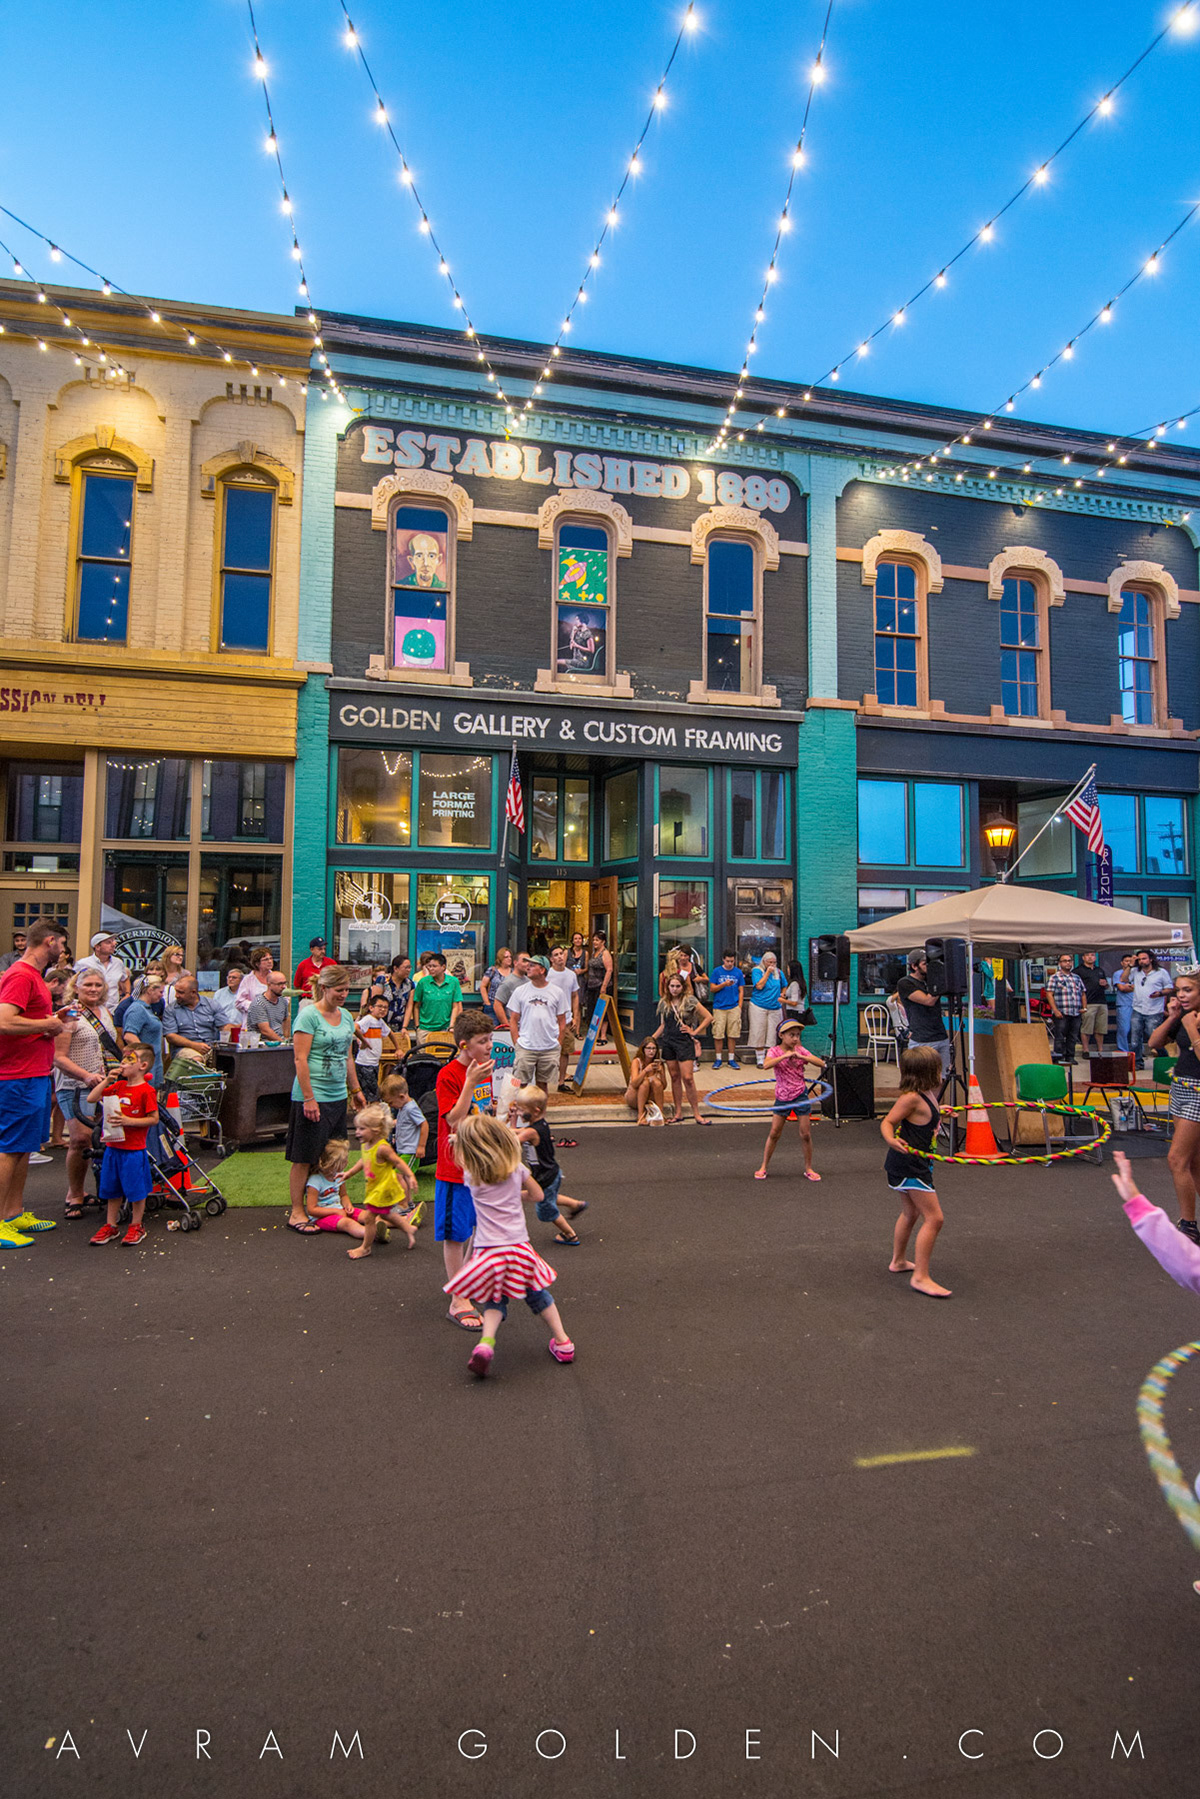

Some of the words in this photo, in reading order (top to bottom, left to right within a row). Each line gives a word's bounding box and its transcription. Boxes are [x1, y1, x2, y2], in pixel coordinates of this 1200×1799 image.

[361, 426, 691, 500] ESTABLISHED
[697, 469, 791, 513] 1889
[339, 704, 441, 732] GOLDEN
[453, 712, 551, 739] GALLERY
[559, 718, 576, 741] &
[583, 720, 677, 747] CUSTOM
[685, 727, 783, 753] FRAMING
[432, 791, 476, 800] LARGE
[432, 800, 476, 809] FORMAT
[432, 809, 476, 818] PRINTING
[1100, 848, 1110, 895] SALON
[115, 930, 178, 946] NTERMISSION
